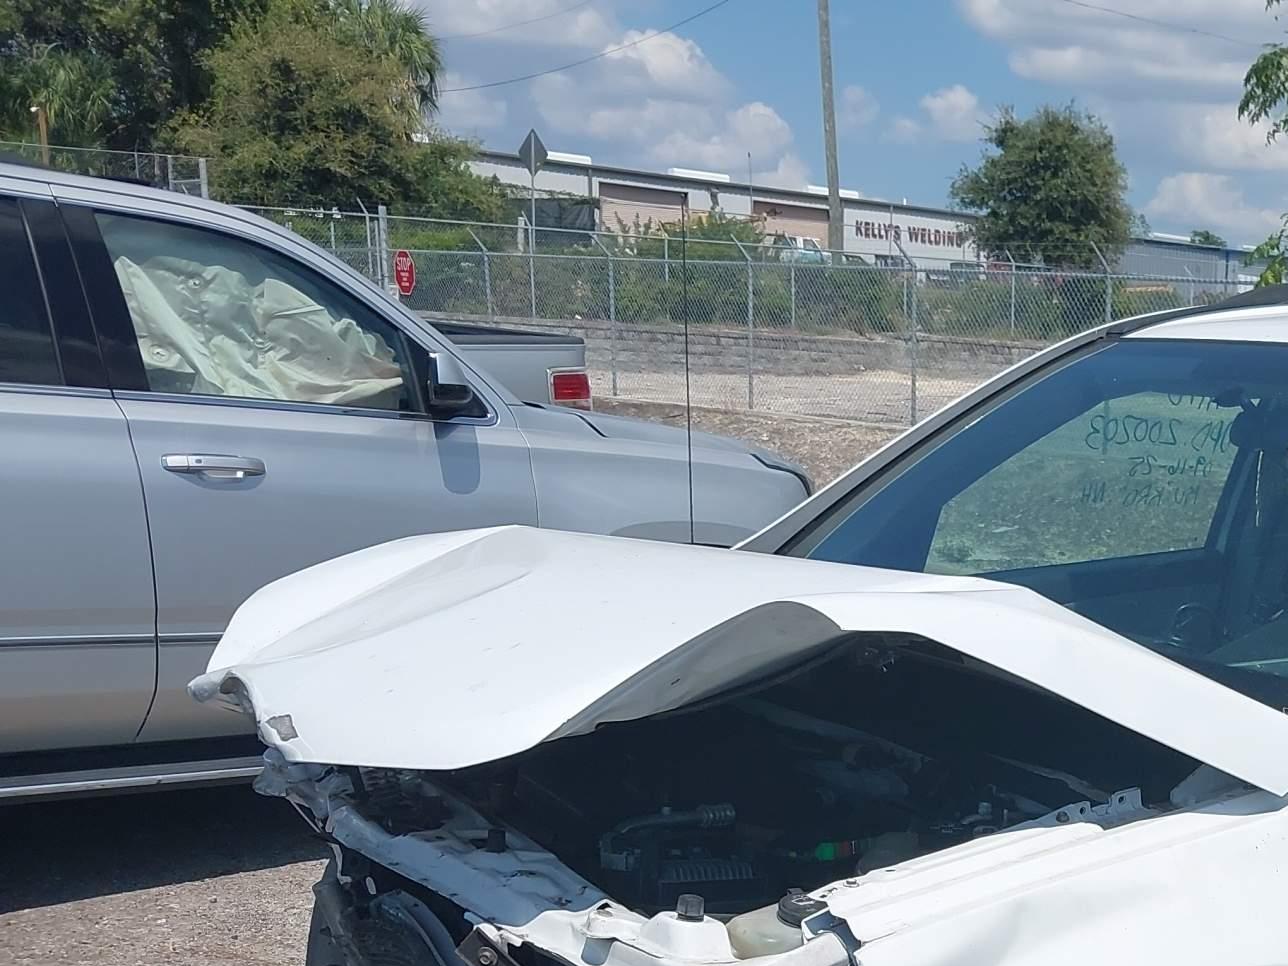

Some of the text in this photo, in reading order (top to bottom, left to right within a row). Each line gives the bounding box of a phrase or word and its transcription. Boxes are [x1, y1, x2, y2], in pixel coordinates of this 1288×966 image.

[855, 219, 964, 249] KELLY'S WELDING
[396, 256, 411, 271] STOP
